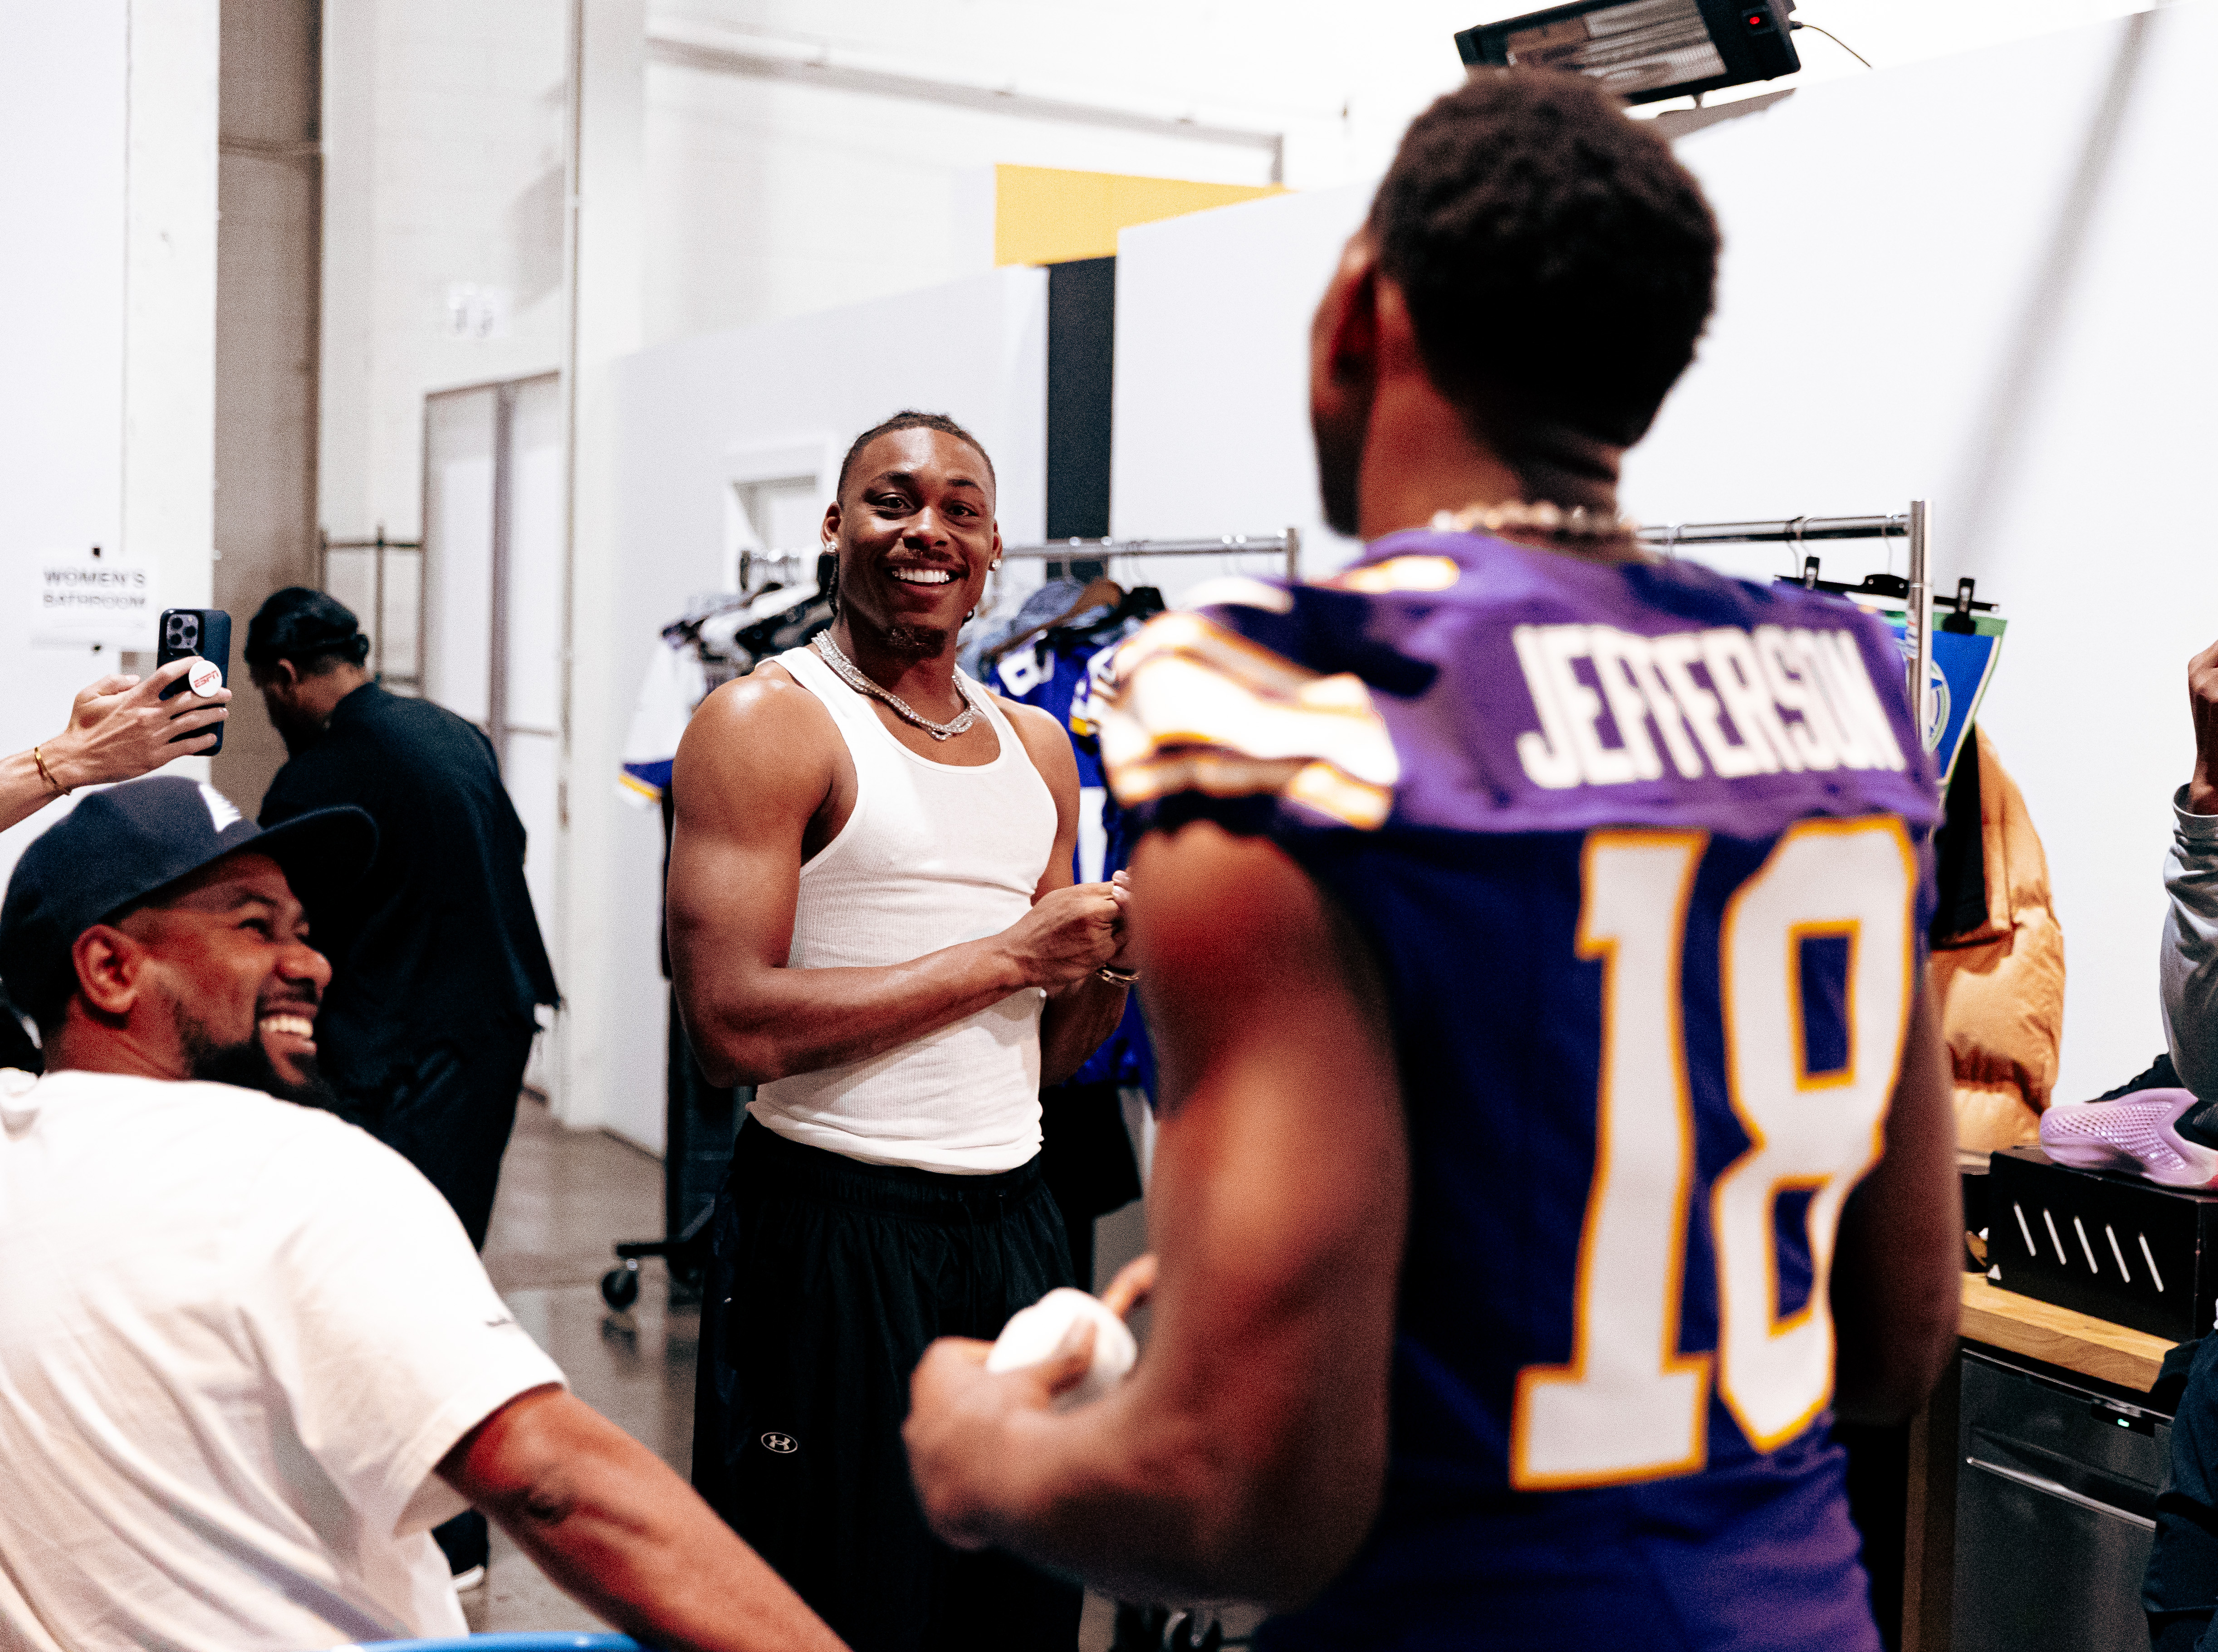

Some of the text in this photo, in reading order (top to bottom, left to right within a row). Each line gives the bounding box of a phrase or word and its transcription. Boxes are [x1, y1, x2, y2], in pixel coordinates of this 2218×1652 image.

[194, 670, 219, 688] ESPN
[1513, 624, 1907, 787] JEFFERSON
[1509, 814, 1919, 1491] 18
